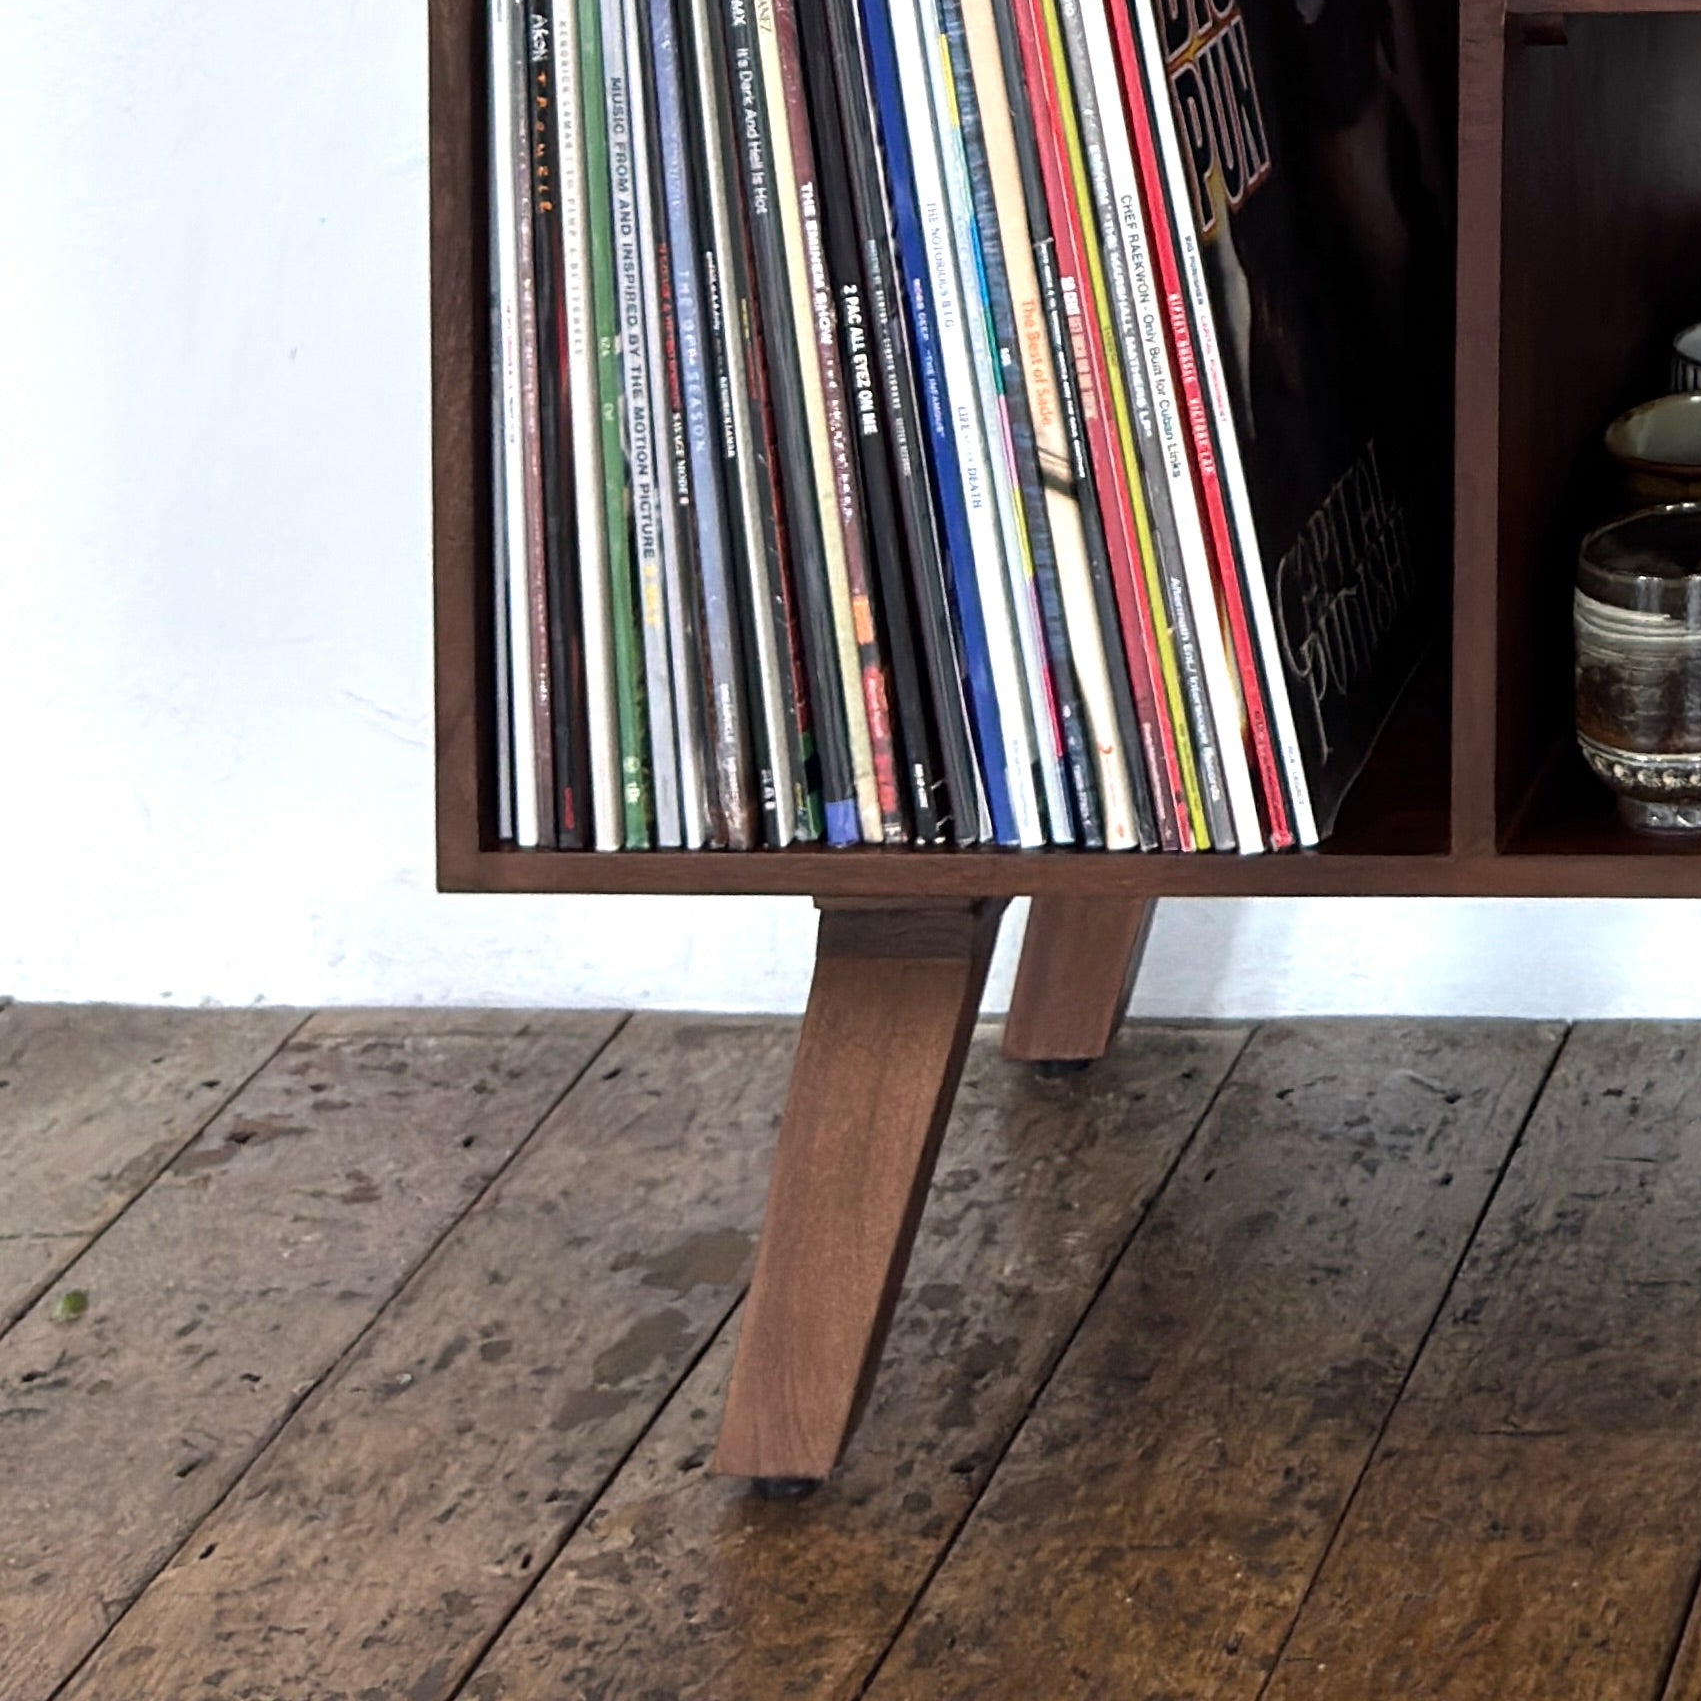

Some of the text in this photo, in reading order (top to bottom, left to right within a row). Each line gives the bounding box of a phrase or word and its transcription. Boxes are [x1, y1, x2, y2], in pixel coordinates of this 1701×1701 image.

[610, 77, 625, 134] MUSIC
[739, 70, 753, 105] Dark
[743, 107, 758, 135] And
[1171, 14, 1271, 233] PUN
[613, 142, 629, 191] FROM
[747, 141, 764, 168] Hell
[750, 171, 765, 184] Is
[617, 199, 632, 235] AND
[753, 187, 768, 214] Hot
[621, 243, 638, 326] INSPIRED
[800, 181, 832, 344] THE EMINEM SHOW
[627, 335, 640, 356] BY
[843, 284, 877, 434] 2 PAC ALL EYEZ ON ME
[1020, 299, 1054, 426] The Best of Sade
[1119, 194, 1183, 477] CHEF RAEKWON Only Built for Cuban Links
[630, 365, 643, 398] THE
[632, 406, 648, 469] MOTION
[956, 405, 982, 509] LIFE DEATH
[638, 483, 655, 558] PICTURE
